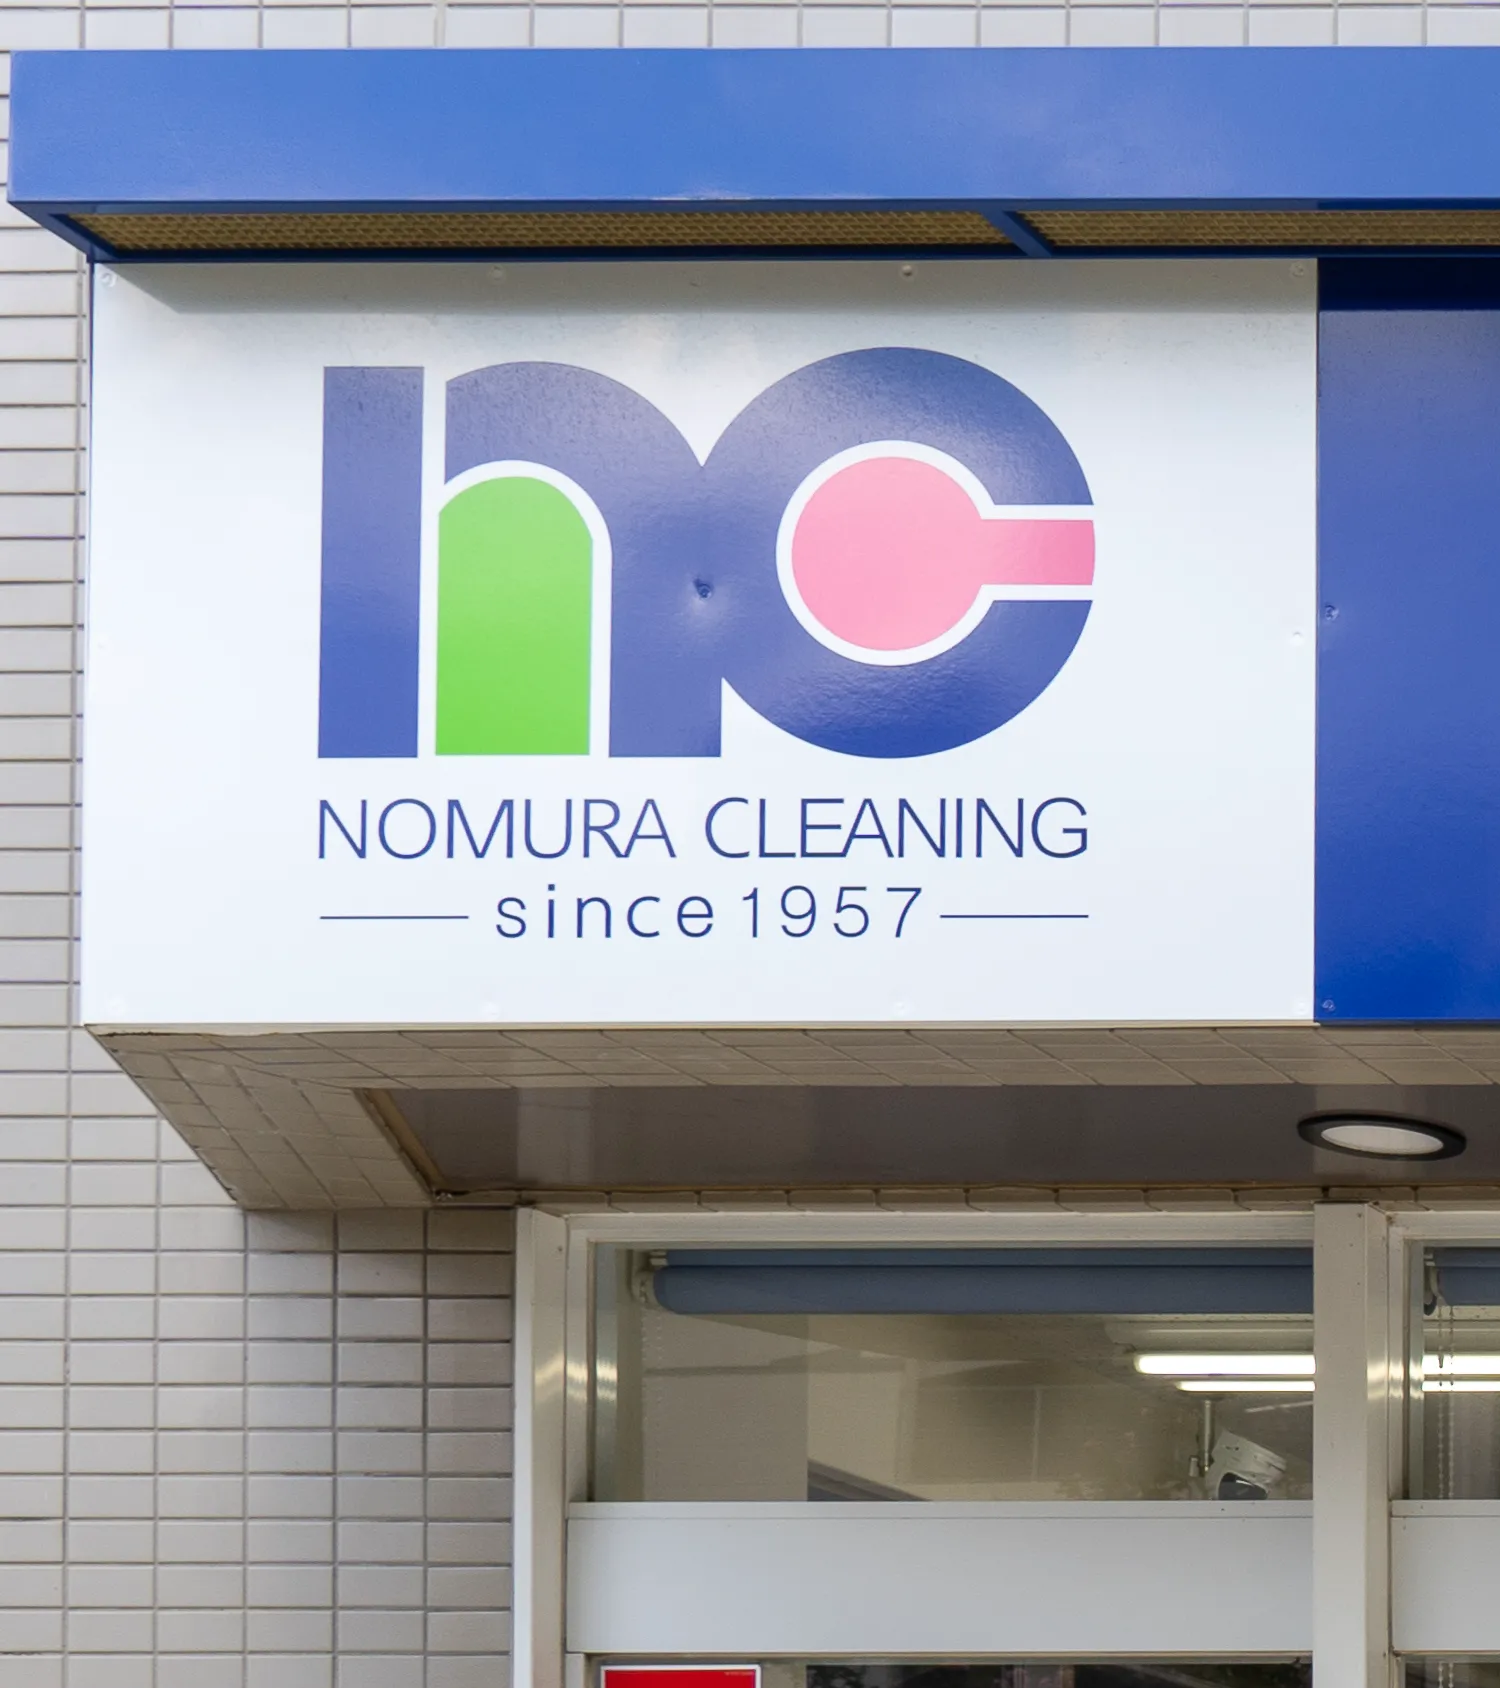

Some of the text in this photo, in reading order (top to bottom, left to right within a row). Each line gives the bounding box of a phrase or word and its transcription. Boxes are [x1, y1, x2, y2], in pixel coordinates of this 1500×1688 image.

[316, 796, 1090, 859] NOMURA CLEANING
[495, 885, 925, 941] since 1957
